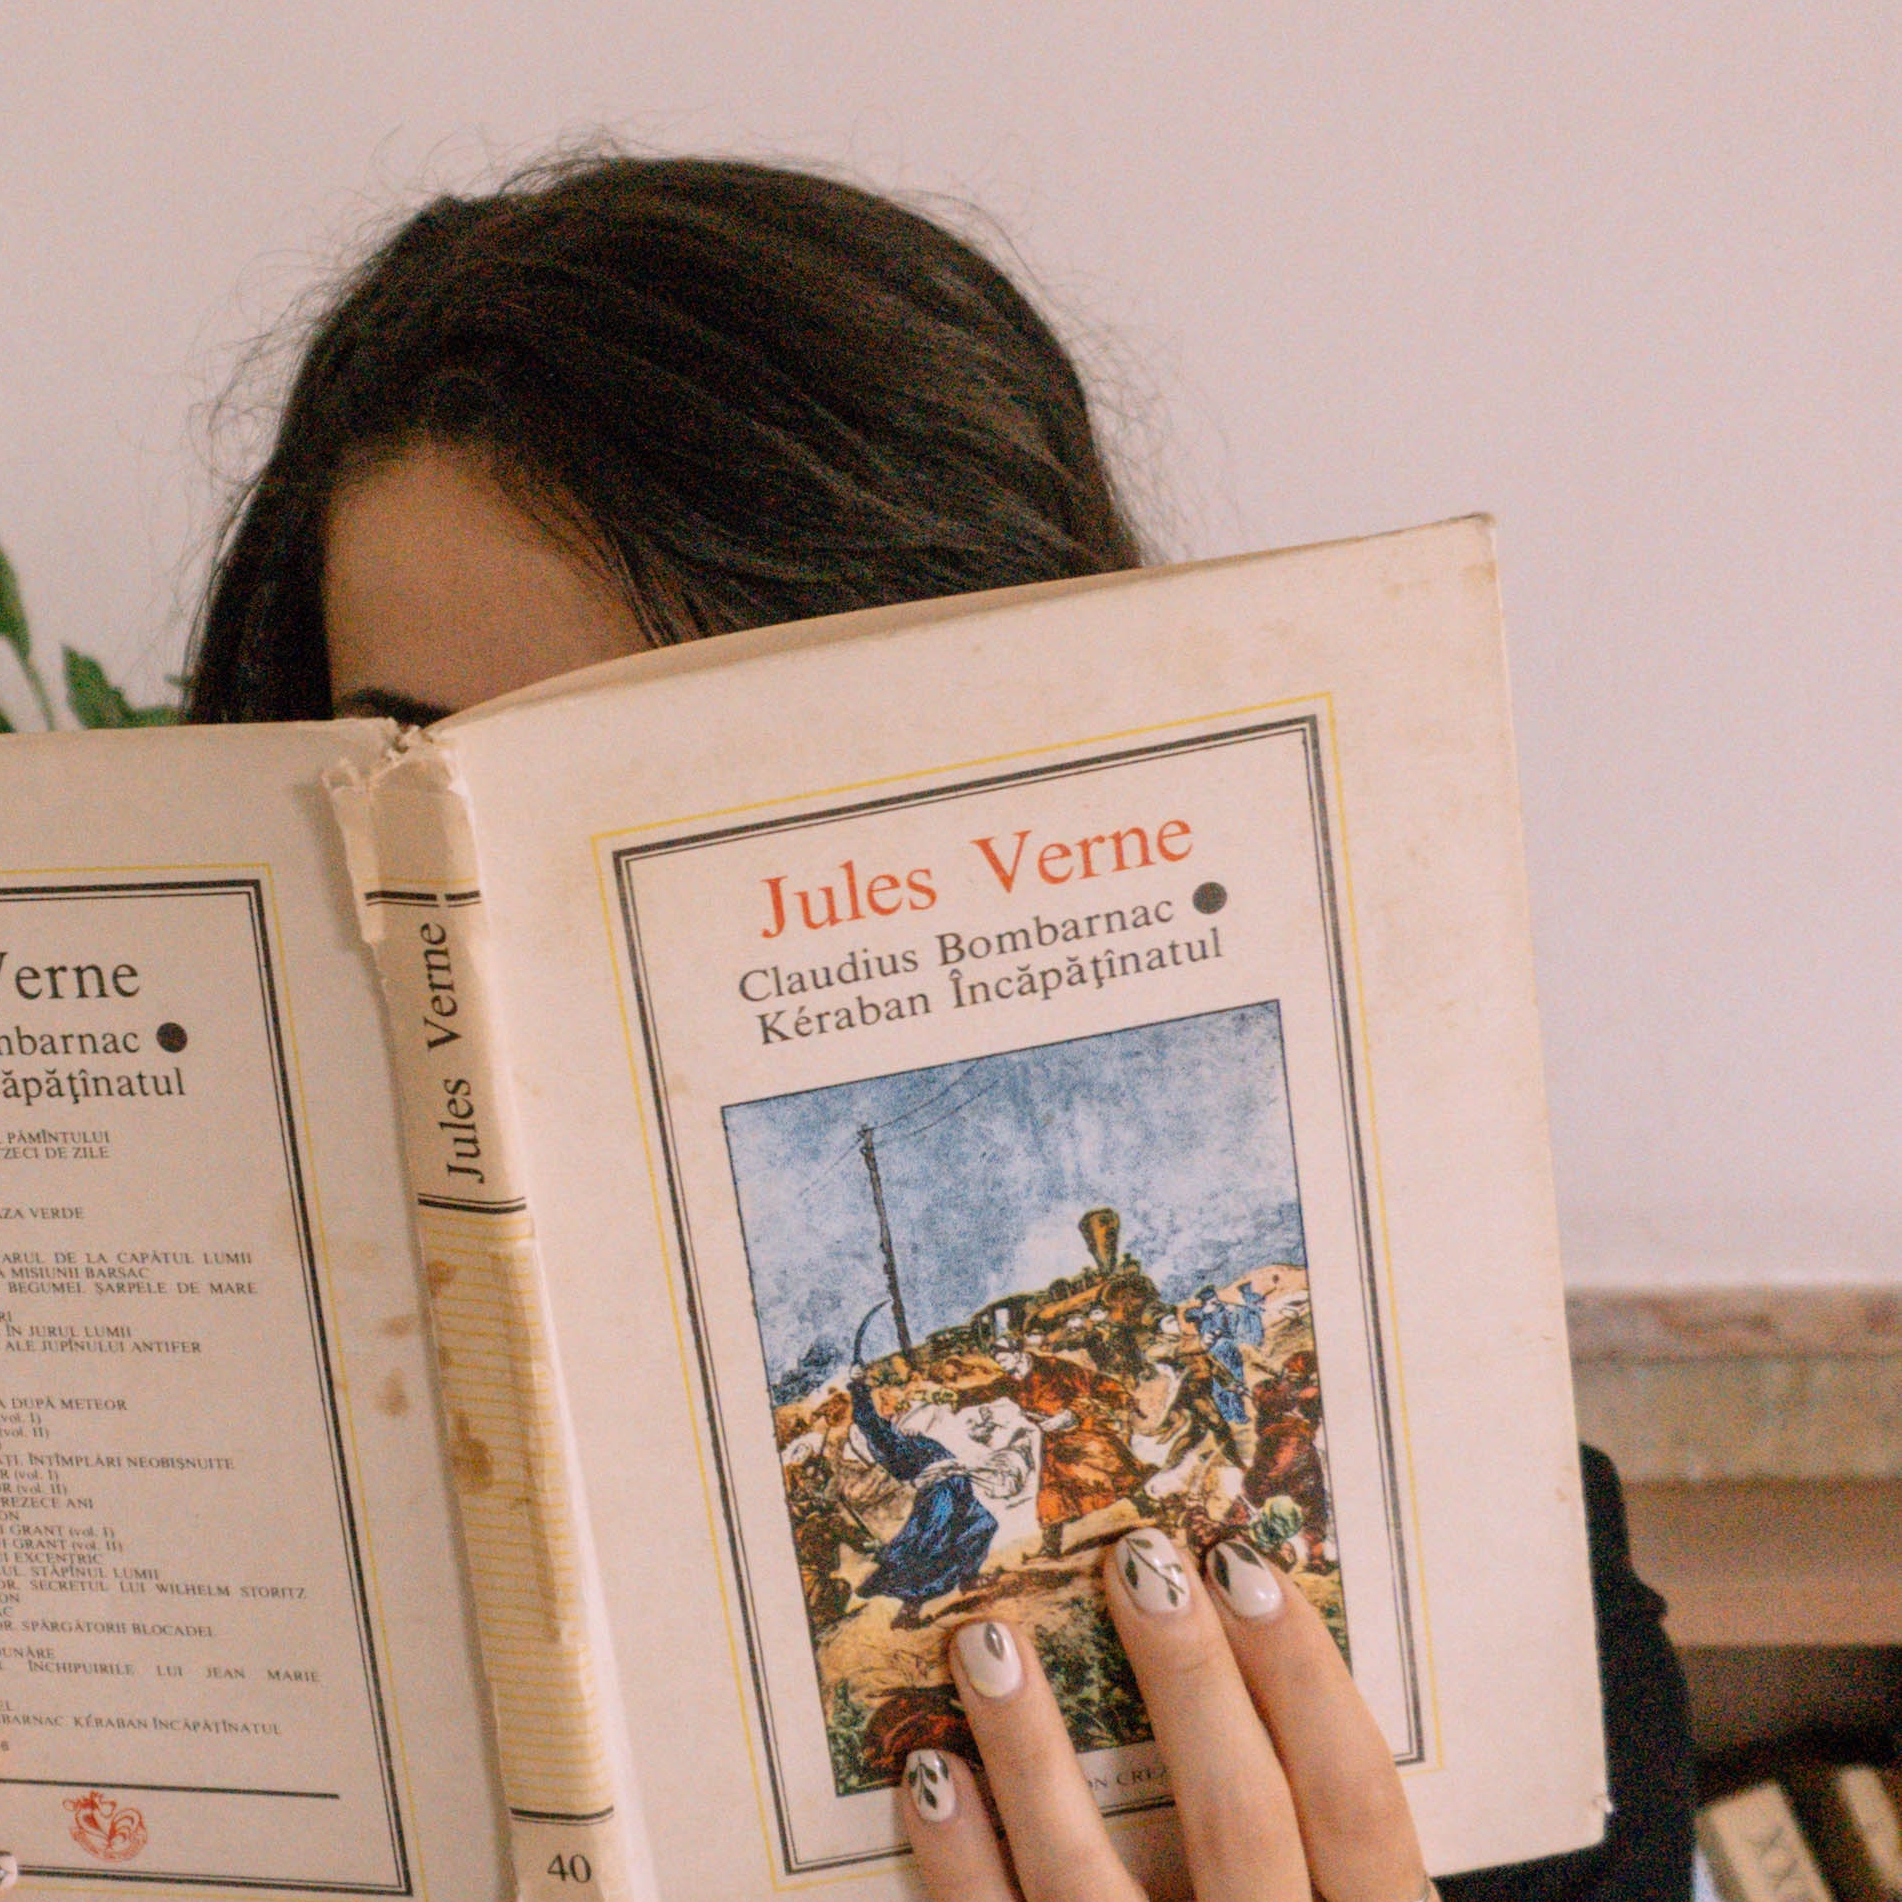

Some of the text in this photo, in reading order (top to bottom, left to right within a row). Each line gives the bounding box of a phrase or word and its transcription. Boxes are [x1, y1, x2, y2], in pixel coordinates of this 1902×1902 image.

[760, 818, 1193, 939] Jules Verne
[738, 900, 1174, 1002] Claudius Bombarnac
[756, 990, 931, 1046] Kéraban
[420, 922, 485, 1185] Jules Verne
[45, 1147, 70, 1159] DE
[73, 1147, 110, 1159] ZILE
[30, 1208, 84, 1219] VERDE
[54, 1252, 76, 1264] DE
[86, 1252, 108, 1264] LA
[203, 1253, 252, 1264] LUMII
[11, 1266, 79, 1278] MISIUNII
[85, 1266, 148, 1278] BARSAC
[177, 1282, 199, 1294] DE
[209, 1282, 258, 1294] MARE
[28, 1325, 78, 1337] JURUL
[84, 1326, 131, 1338] LUMII
[5, 1339, 35, 1351] ALE
[131, 1341, 202, 1353] ANTIFER
[61, 1398, 129, 1410] METEOR
[547, 1853, 592, 1883] 40
